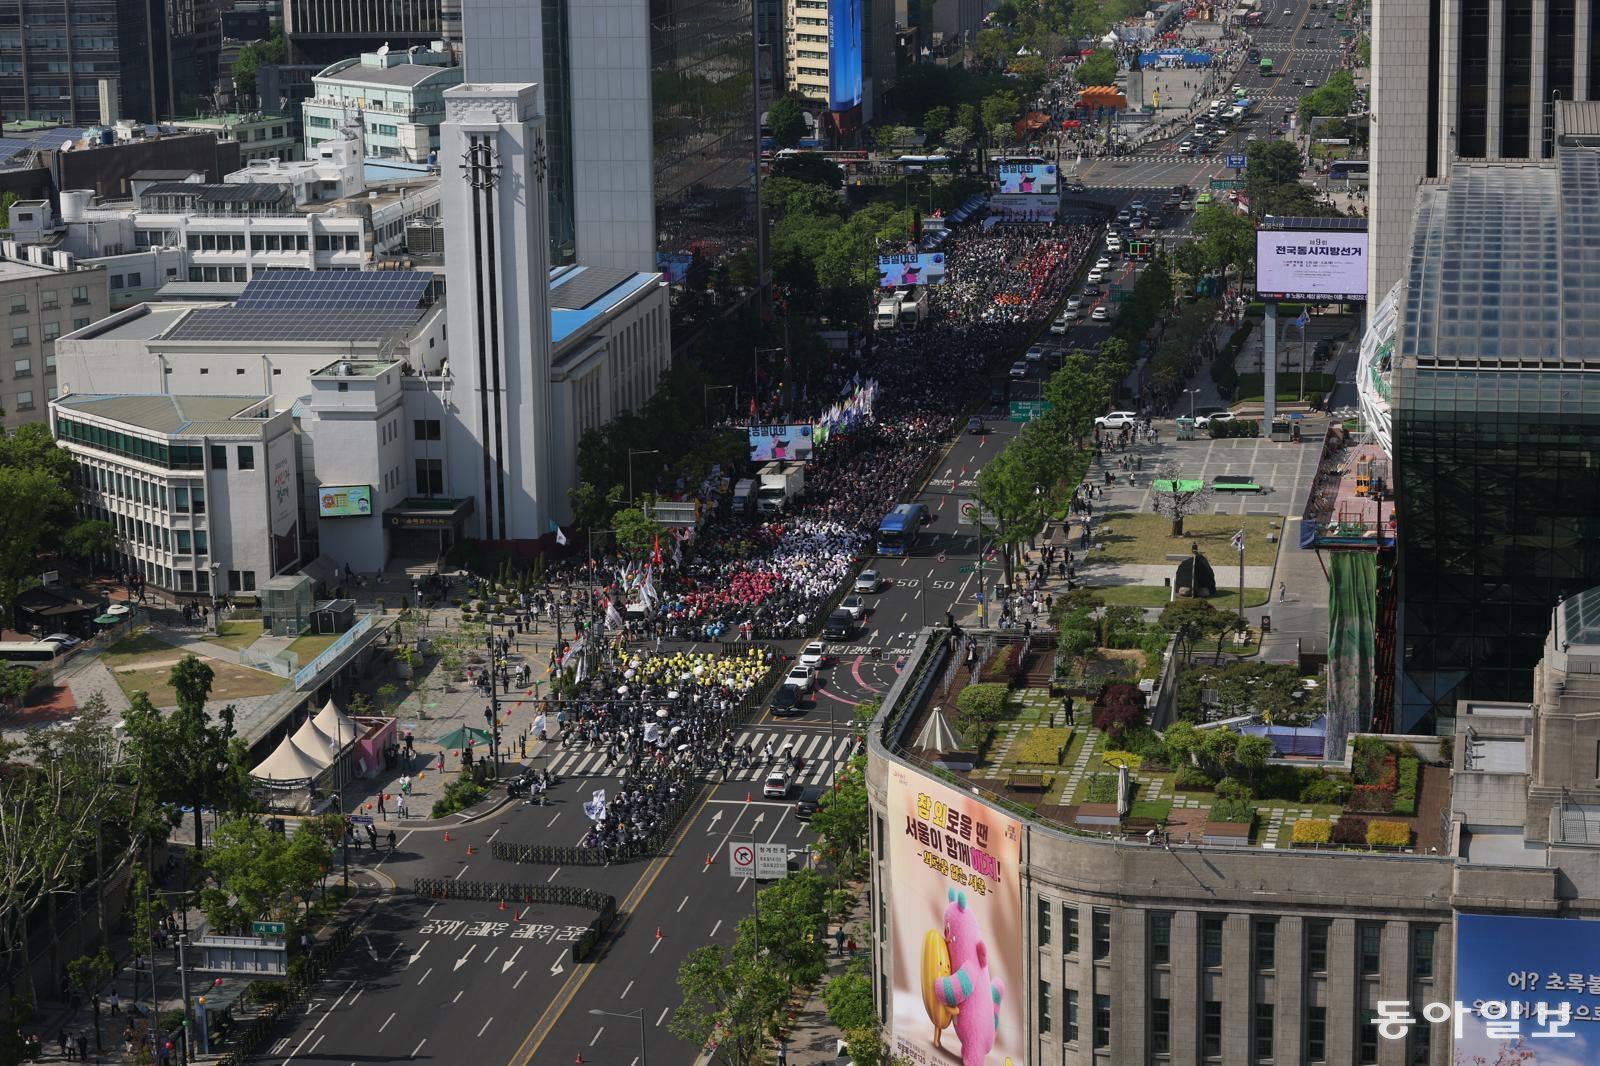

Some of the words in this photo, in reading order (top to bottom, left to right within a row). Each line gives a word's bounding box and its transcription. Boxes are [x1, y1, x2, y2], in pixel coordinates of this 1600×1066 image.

[1275, 245, 1362, 257] 전국동시지방선거
[897, 578, 919, 587] 50
[932, 580, 955, 590] 50
[917, 792, 932, 820] 참
[933, 800, 973, 841] 외로울
[975, 821, 989, 849] 땐
[905, 815, 943, 852] 서울이
[923, 850, 949, 877] 외로움
[949, 863, 968, 886] 없는
[968, 874, 987, 896] 서울
[419, 919, 466, 935] 서소문
[1507, 971, 1539, 991] 어?
